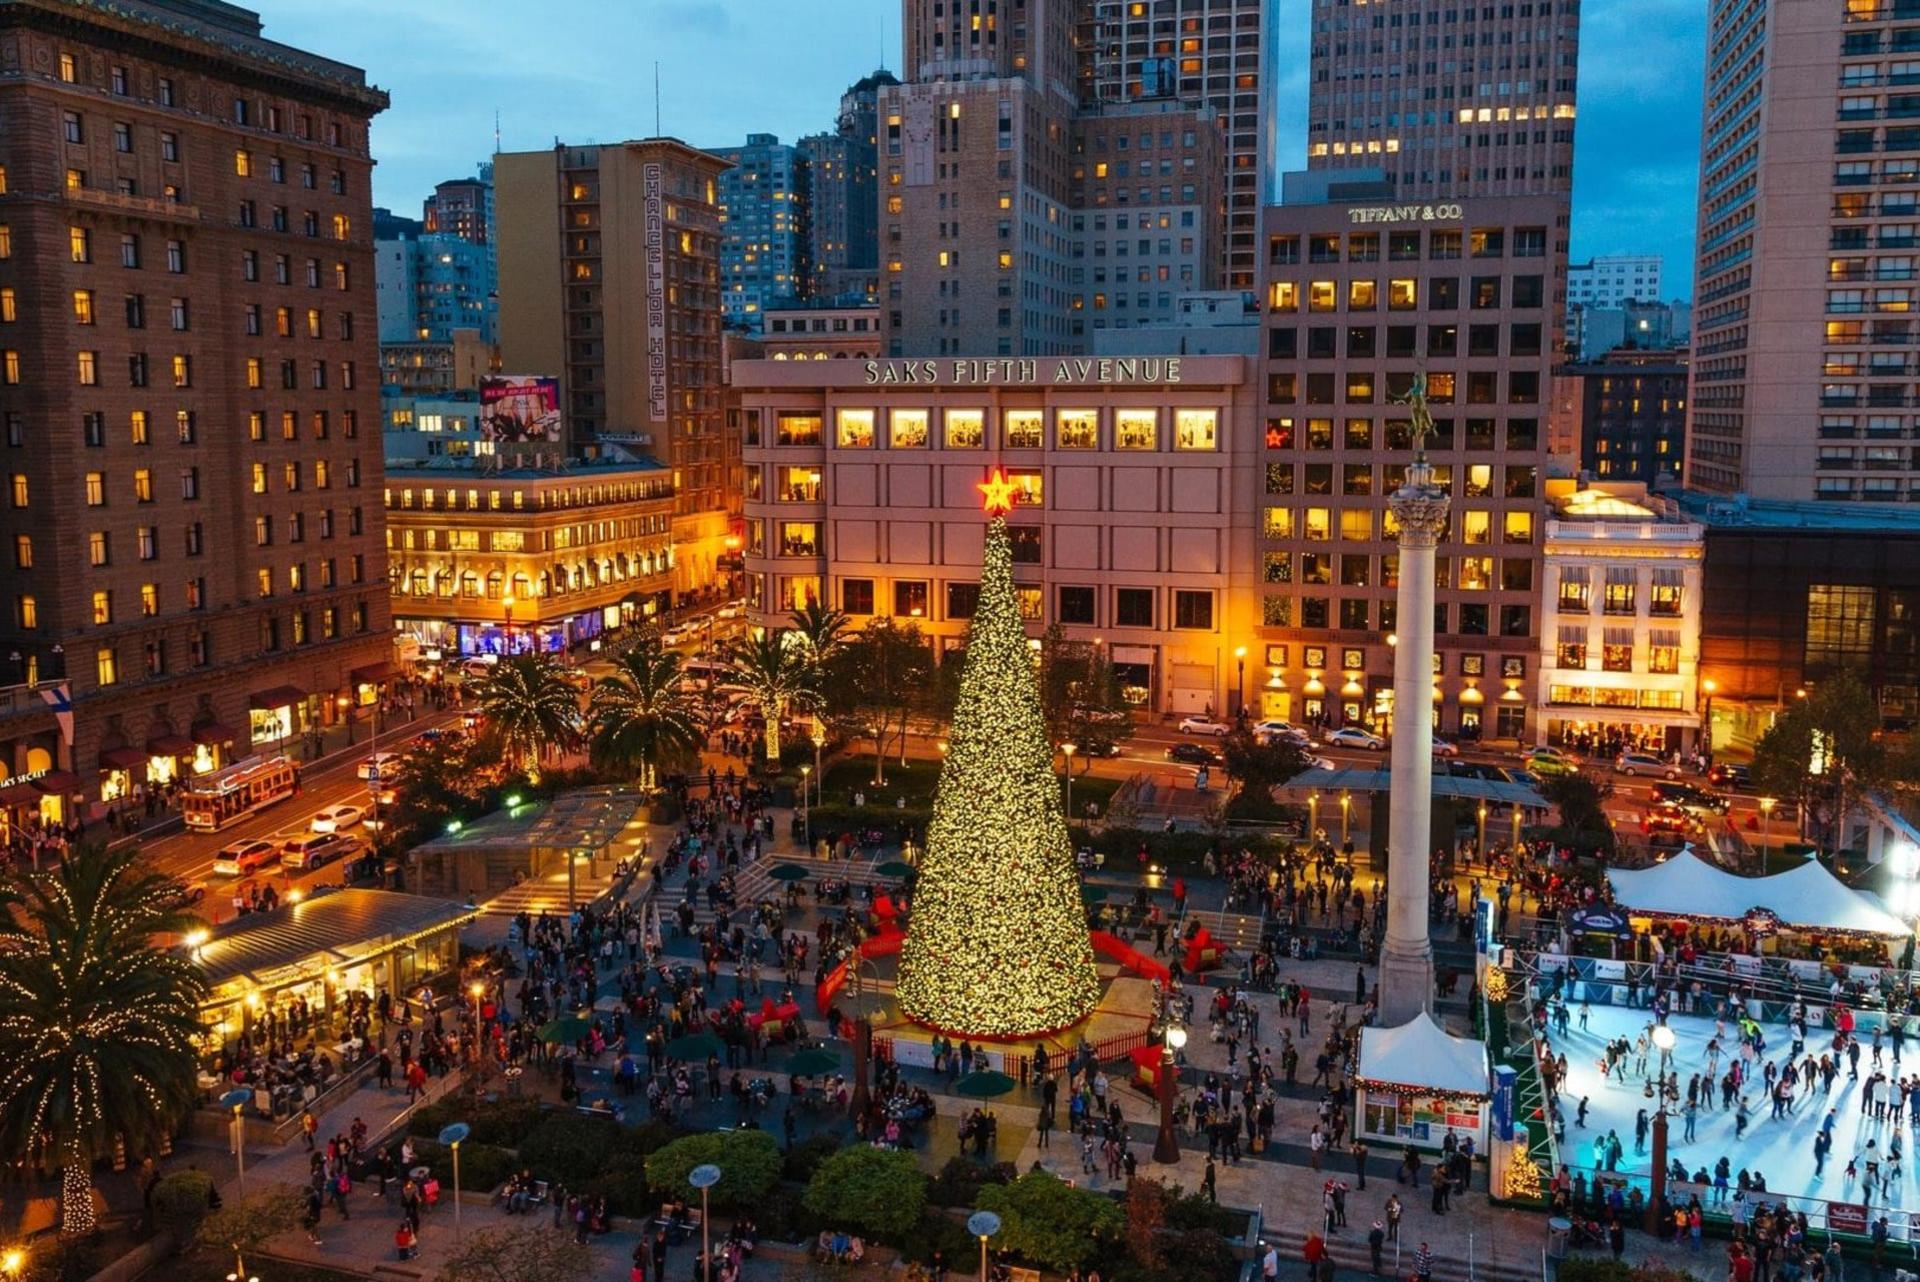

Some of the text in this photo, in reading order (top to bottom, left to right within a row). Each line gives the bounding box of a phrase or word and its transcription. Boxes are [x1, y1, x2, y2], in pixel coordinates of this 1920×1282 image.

[1348, 204, 1463, 223] TIFFANY & CO.
[645, 165, 665, 417] CHANCELLOR HOTEL
[864, 358, 1181, 384] SAKS FIFTH AVENUE
